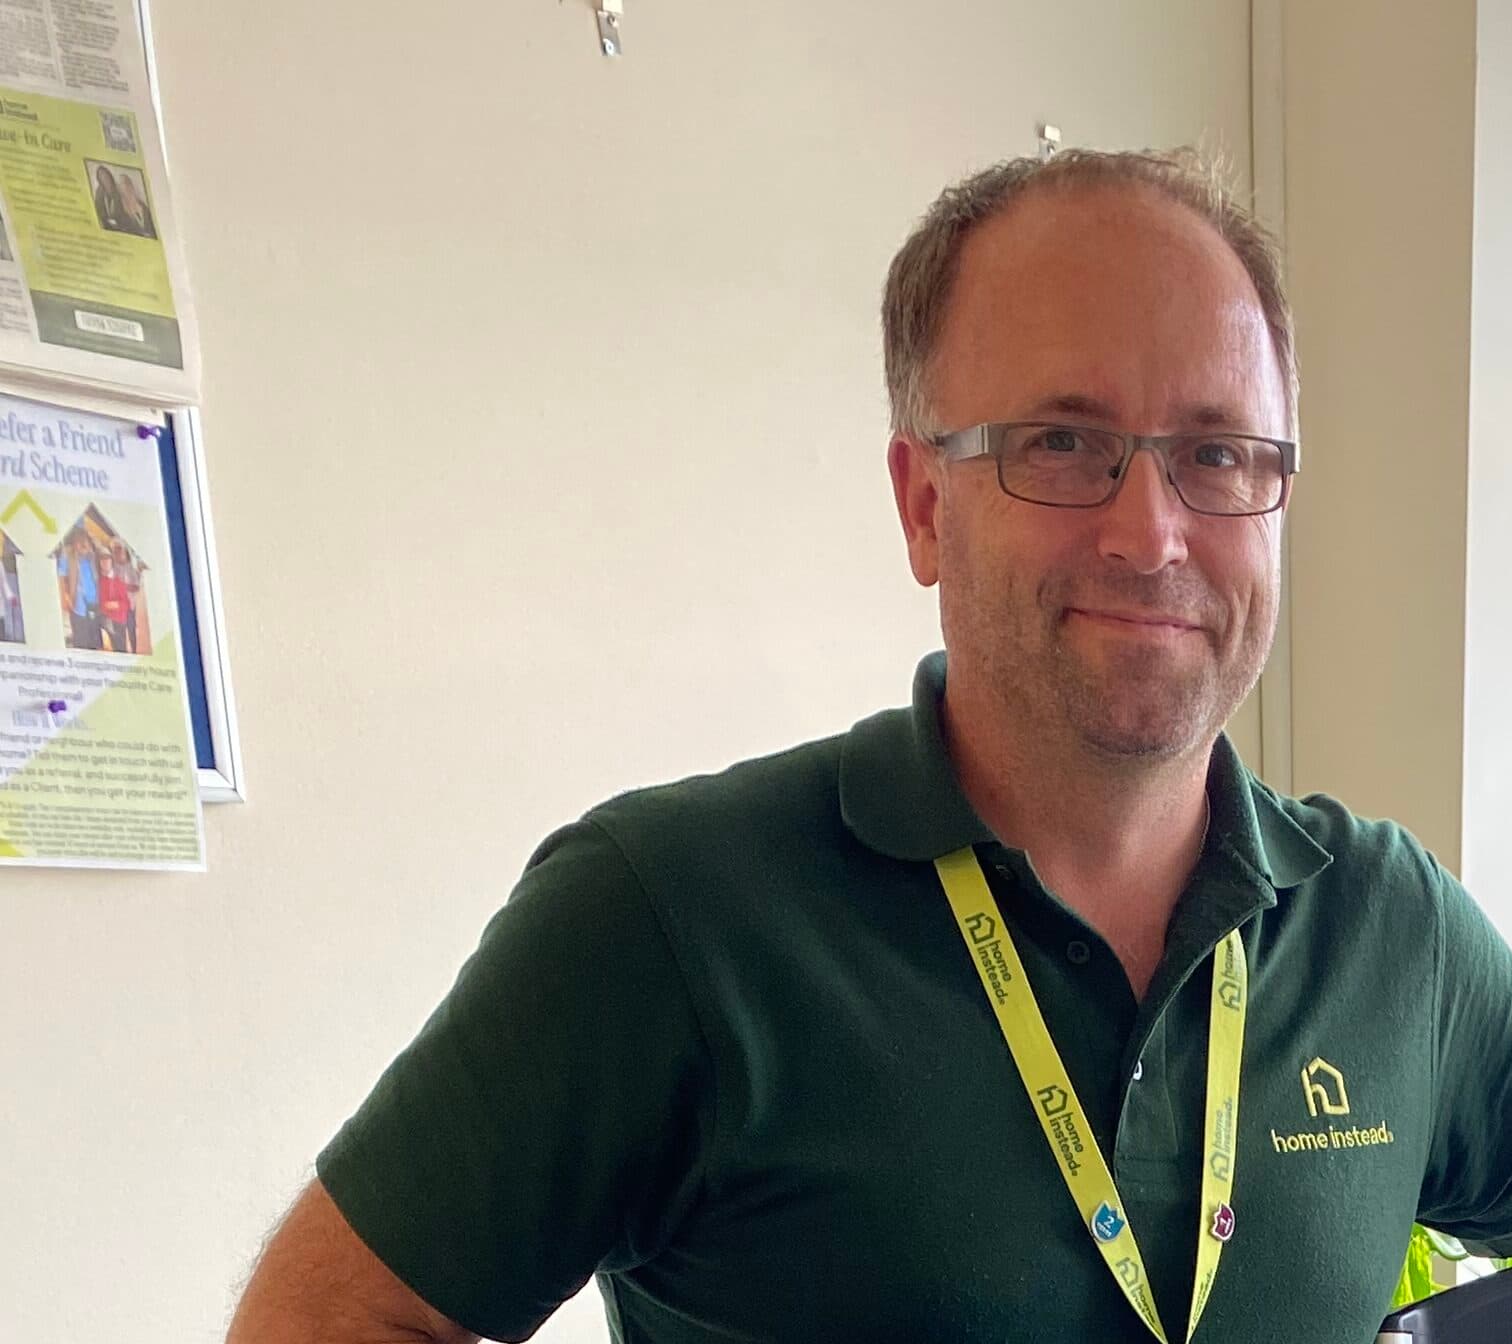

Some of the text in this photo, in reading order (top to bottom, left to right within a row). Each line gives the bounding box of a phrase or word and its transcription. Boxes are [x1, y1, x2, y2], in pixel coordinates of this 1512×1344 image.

[41, 425, 56, 448] a
[57, 420, 125, 458] Friend
[29, 450, 109, 490] Scheme
[989, 939, 1012, 983] home
[1058, 1111, 1084, 1153] home
[1211, 1108, 1224, 1150] home
[1270, 1128, 1329, 1153] home
